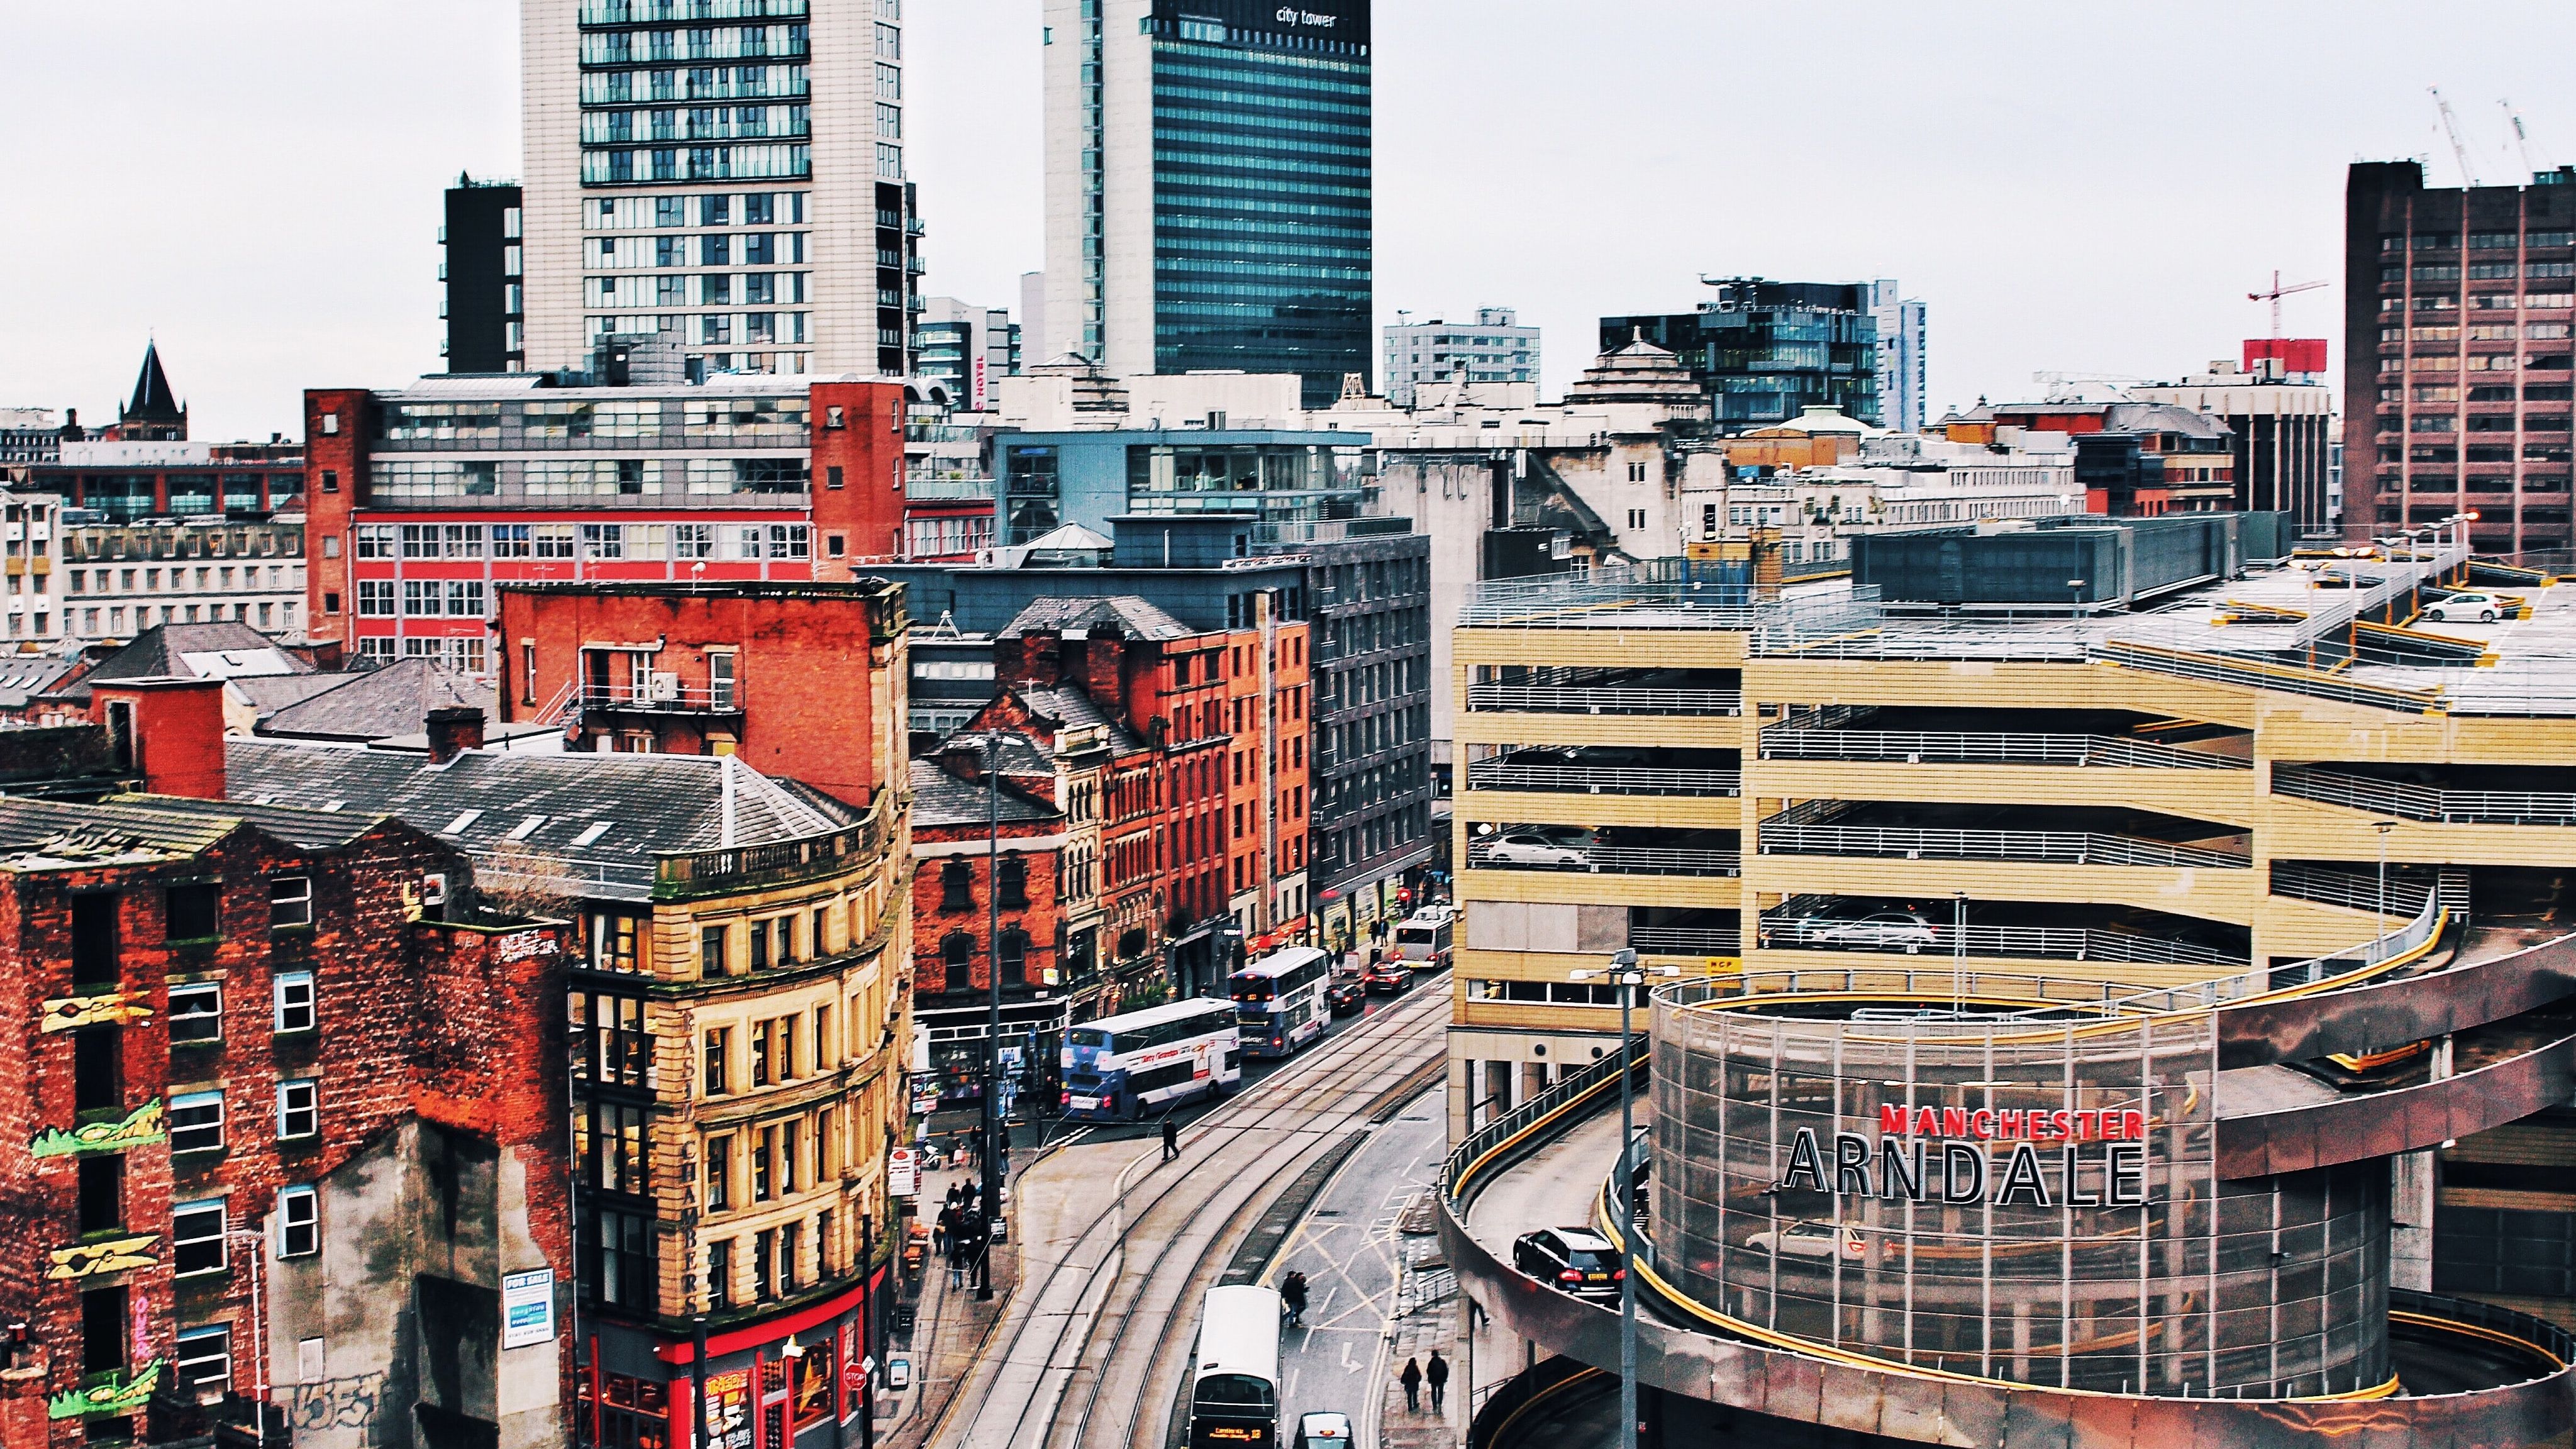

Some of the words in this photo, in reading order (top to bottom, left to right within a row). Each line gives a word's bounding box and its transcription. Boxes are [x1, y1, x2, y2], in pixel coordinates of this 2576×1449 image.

[1276, 6, 1299, 27] city
[1301, 10, 1337, 28] tower
[976, 355, 984, 396] HOTEL
[1881, 1103, 2145, 1140] MANCHESTER
[1781, 1126, 2144, 1208] ARNDALE
[681, 1140, 699, 1316] CHAMBERS
[507, 1277, 526, 1289] FOR
[527, 1273, 549, 1285] SALE
[845, 1372, 865, 1381] STOP
